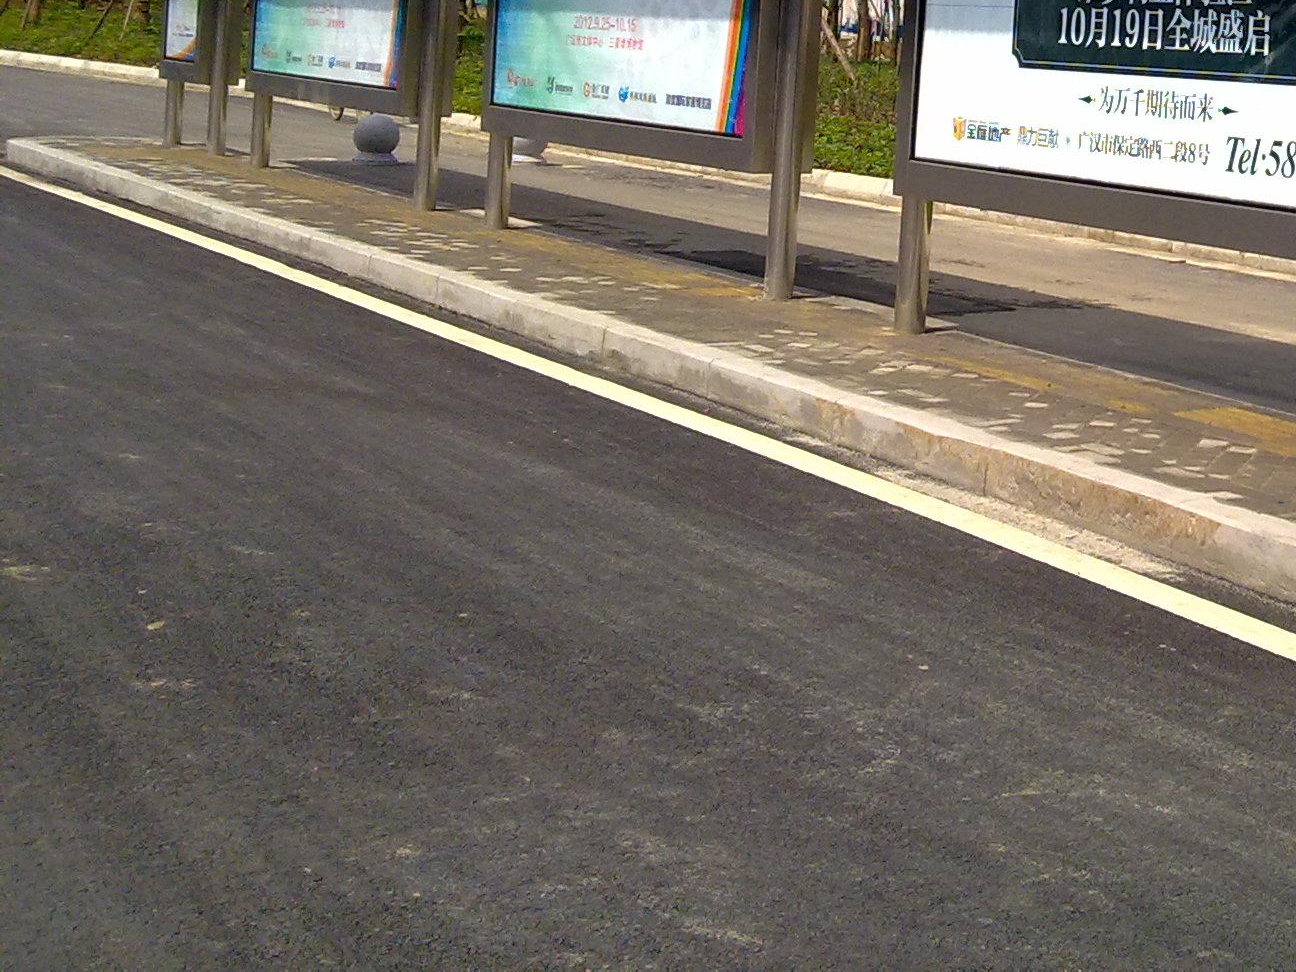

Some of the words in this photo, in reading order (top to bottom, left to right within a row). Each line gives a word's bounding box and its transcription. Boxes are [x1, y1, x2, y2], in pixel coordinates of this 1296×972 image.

[1057, 6, 1271, 56] 10月19日全城盛启
[1099, 86, 1214, 122] 为万千期待而来
